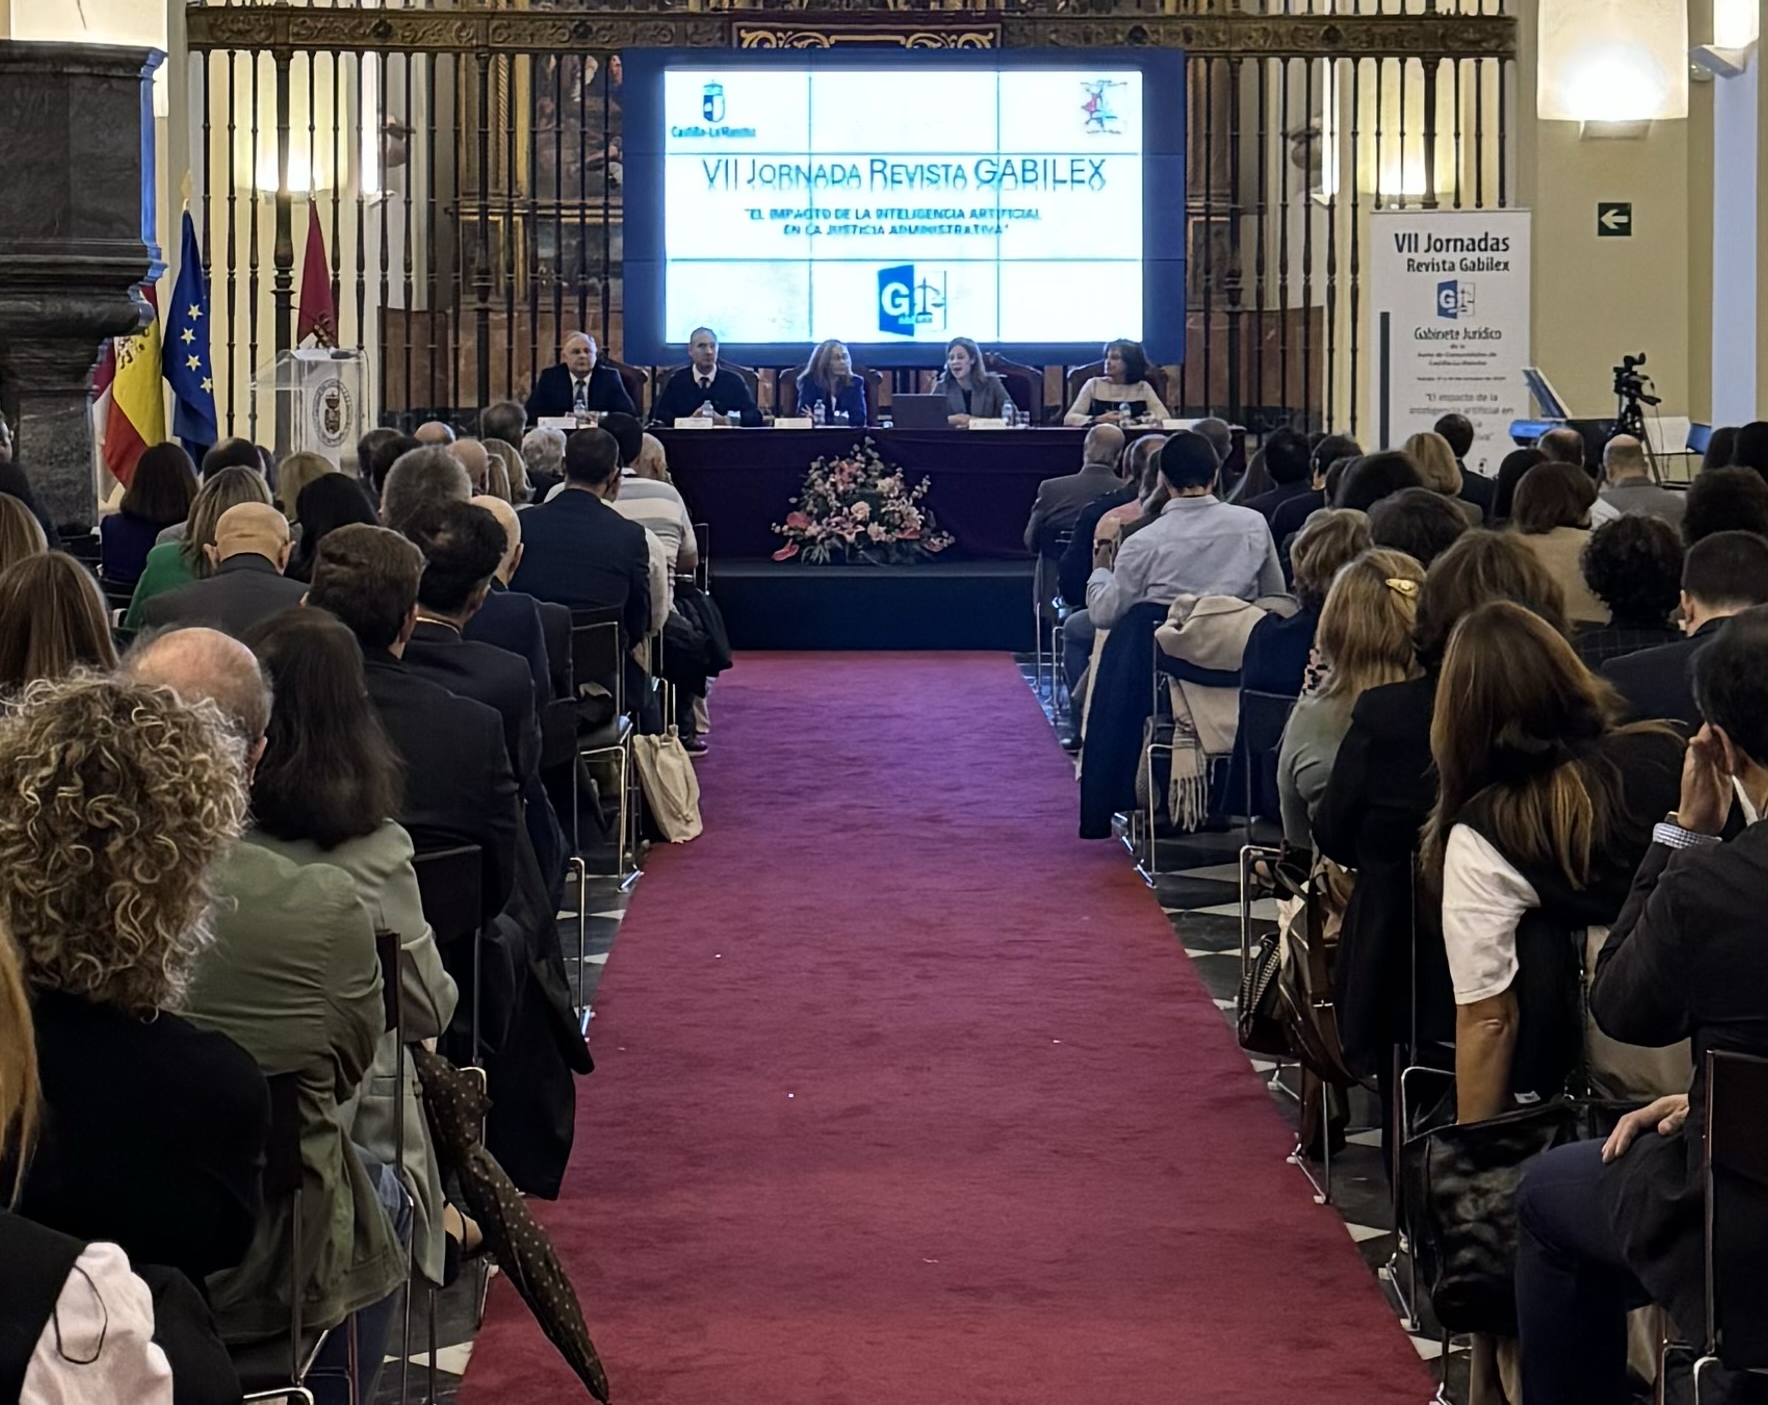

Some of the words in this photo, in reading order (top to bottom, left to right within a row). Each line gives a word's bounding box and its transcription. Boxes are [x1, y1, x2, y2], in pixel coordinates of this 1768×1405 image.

[703, 158, 738, 186] VII
[870, 158, 967, 186] REVISTA
[974, 158, 1106, 186] GABILEX
[834, 208, 851, 220] DE
[855, 208, 872, 220] LA
[1394, 232, 1419, 253] VII
[1424, 231, 1510, 253] Jornadas
[1406, 258, 1456, 273] Revista
[1459, 256, 1510, 272] Gabilex
[1414, 327, 1460, 340] Gabinete
[1462, 327, 1502, 340] Jurídico
